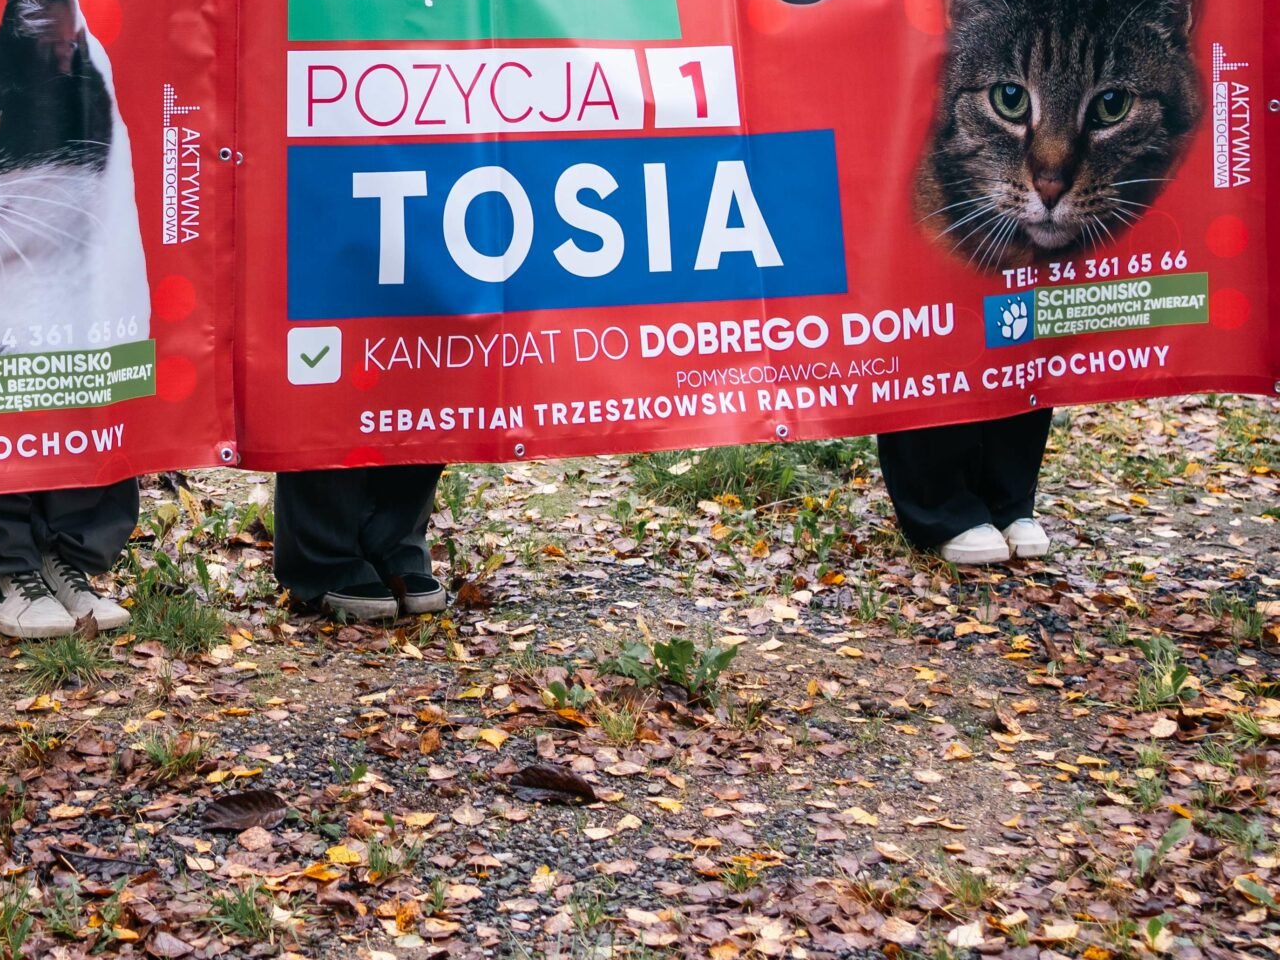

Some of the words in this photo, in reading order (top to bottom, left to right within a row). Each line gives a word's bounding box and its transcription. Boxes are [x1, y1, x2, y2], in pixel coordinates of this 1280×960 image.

[307, 60, 620, 127] POZYCJA
[680, 61, 708, 118] 1
[1214, 83, 1228, 187] CZĘSTOCHOWA
[1231, 81, 1251, 188] AKTYWNA
[163, 128, 177, 243] CZĘSTOCHOWA
[181, 127, 200, 243] AKTYWNA
[352, 160, 784, 285] TOSIA
[1002, 267, 1038, 289] TEL:
[1049, 262, 1076, 282] 34
[1085, 257, 1119, 278] 361
[1128, 253, 1152, 274] 65
[1161, 250, 1188, 270] 66
[1038, 280, 1151, 307] SCHRONISKO
[29, 323, 73, 346] 361
[89, 321, 111, 342] 65
[117, 315, 138, 338] 66
[364, 329, 560, 372] KANDYDAT
[575, 326, 628, 363] DO
[640, 314, 829, 360] DOBREGO
[842, 302, 955, 346] DOMU
[1037, 307, 1063, 321] DLA
[1066, 299, 1141, 319] BEZDOMYCH
[1144, 294, 1206, 310] ZWIERZĄT
[1037, 322, 1051, 335] W
[1054, 313, 1150, 334] CZĘSTOCHOWIE
[7, 374, 104, 393] BEZDOMYCH
[107, 364, 152, 385] ZWIERZĄT
[359, 406, 523, 433] SEBASTIAN
[533, 391, 748, 426] TRZESZKOWSKI
[757, 385, 857, 411] RADNY
[872, 371, 971, 403] MIASTA
[982, 345, 1170, 390] CZĘSTOCHOWY
[676, 363, 842, 388] POMYSŁODAWCA
[848, 356, 900, 378] AKCJI
